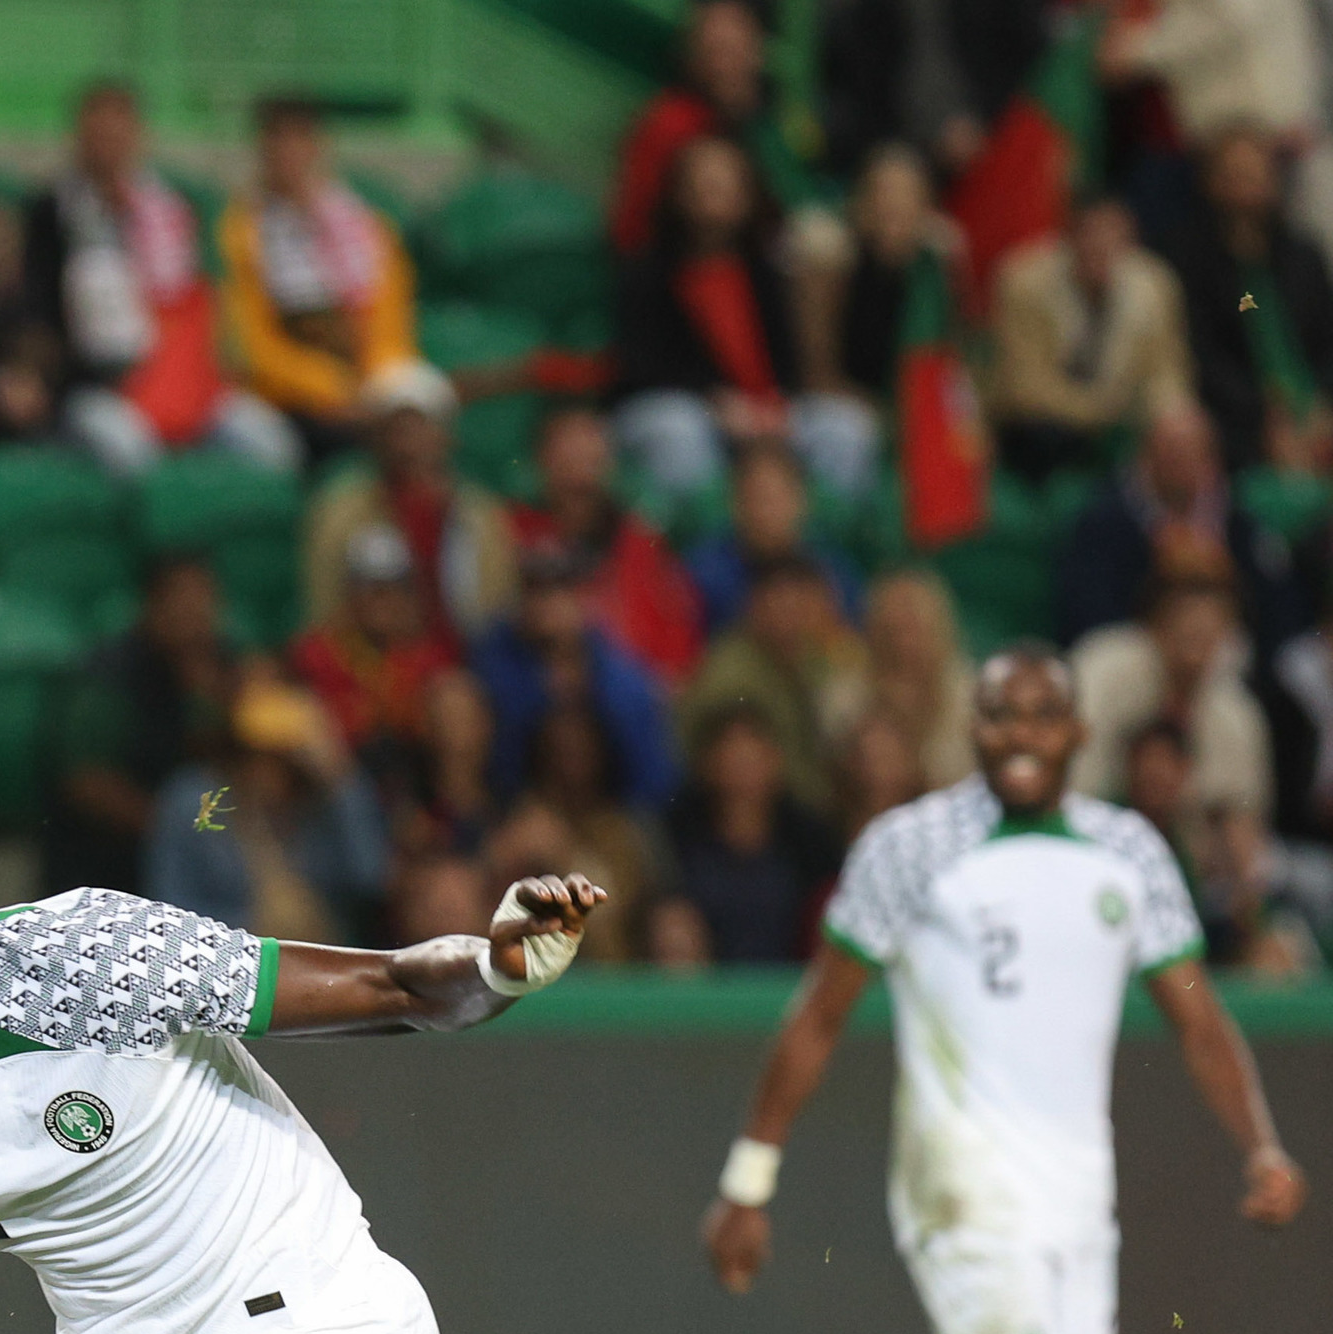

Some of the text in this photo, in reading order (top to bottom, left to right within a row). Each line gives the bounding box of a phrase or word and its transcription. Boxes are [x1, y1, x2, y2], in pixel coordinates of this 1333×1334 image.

[982, 925, 1023, 998] 2
[46, 1094, 72, 1127] FOOTBALL
[71, 1093, 113, 1126] FEDERATION
